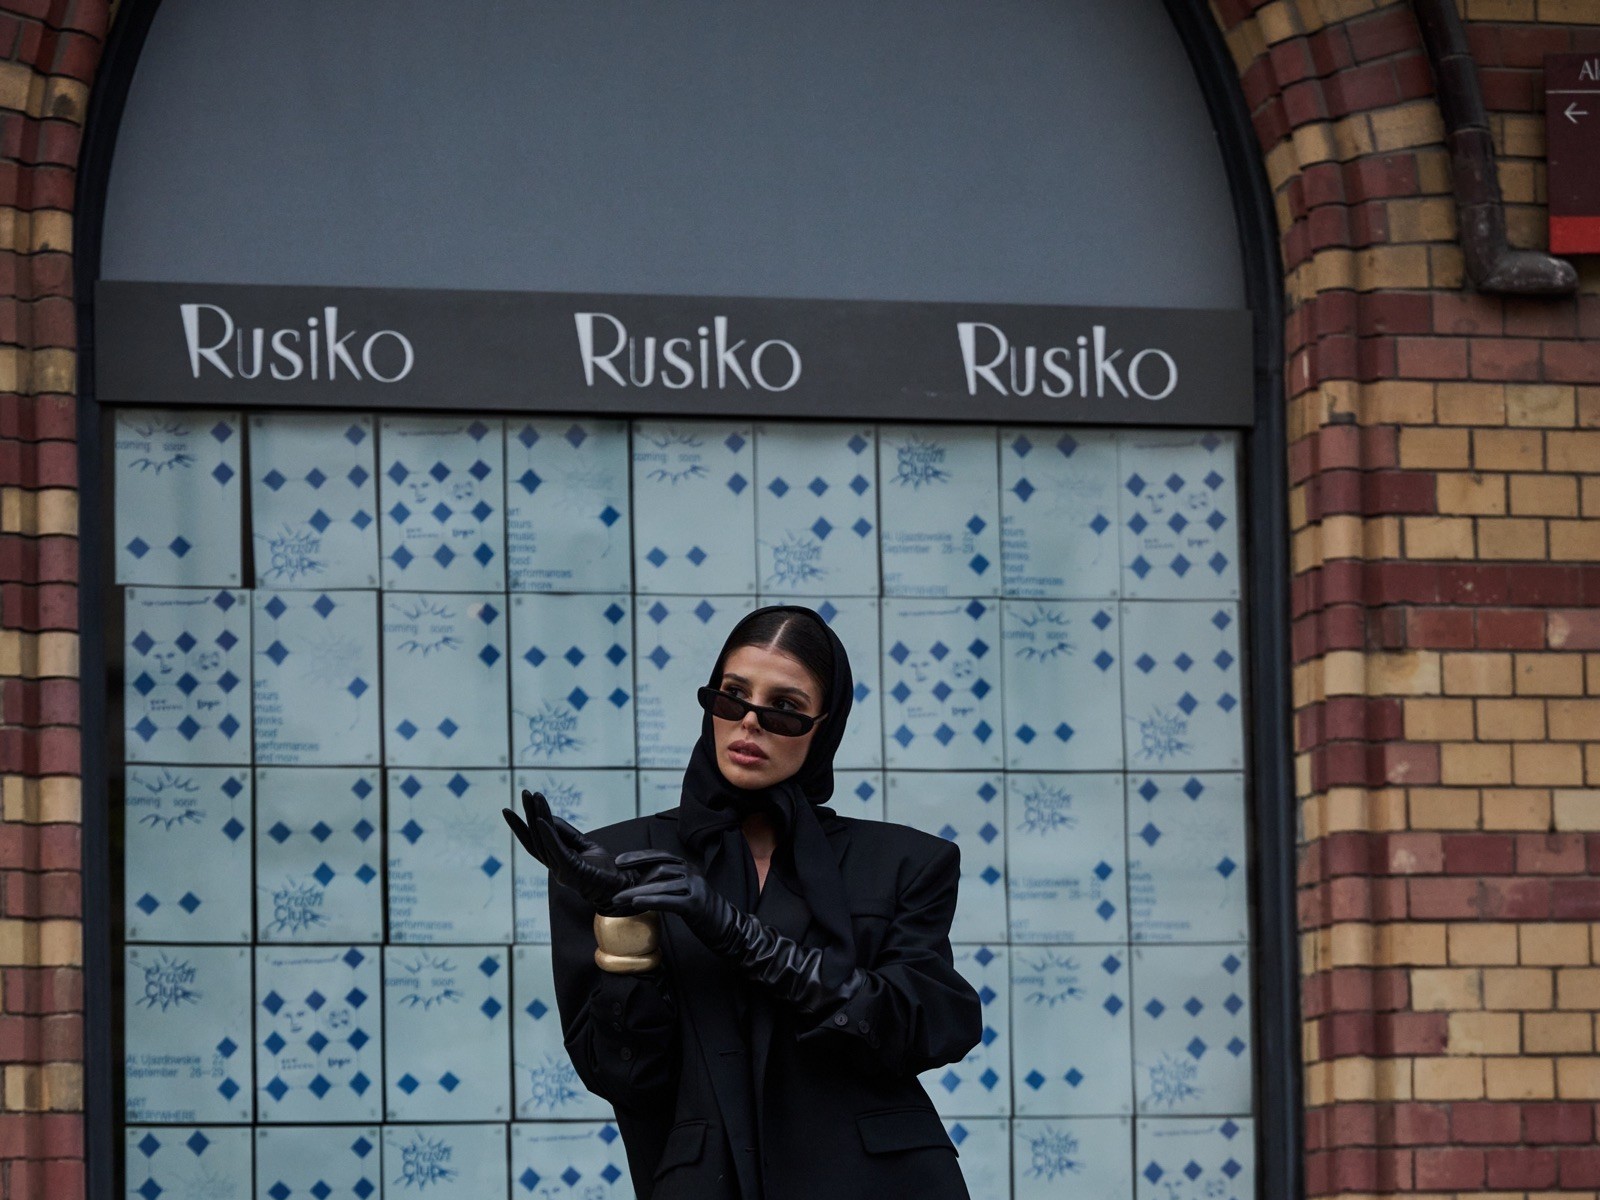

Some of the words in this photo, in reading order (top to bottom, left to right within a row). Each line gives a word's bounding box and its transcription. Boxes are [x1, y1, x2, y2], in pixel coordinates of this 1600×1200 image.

[180, 303, 414, 383] Rusiko
[574, 312, 802, 392] Rusiko
[956, 322, 1178, 400] Rusiko
